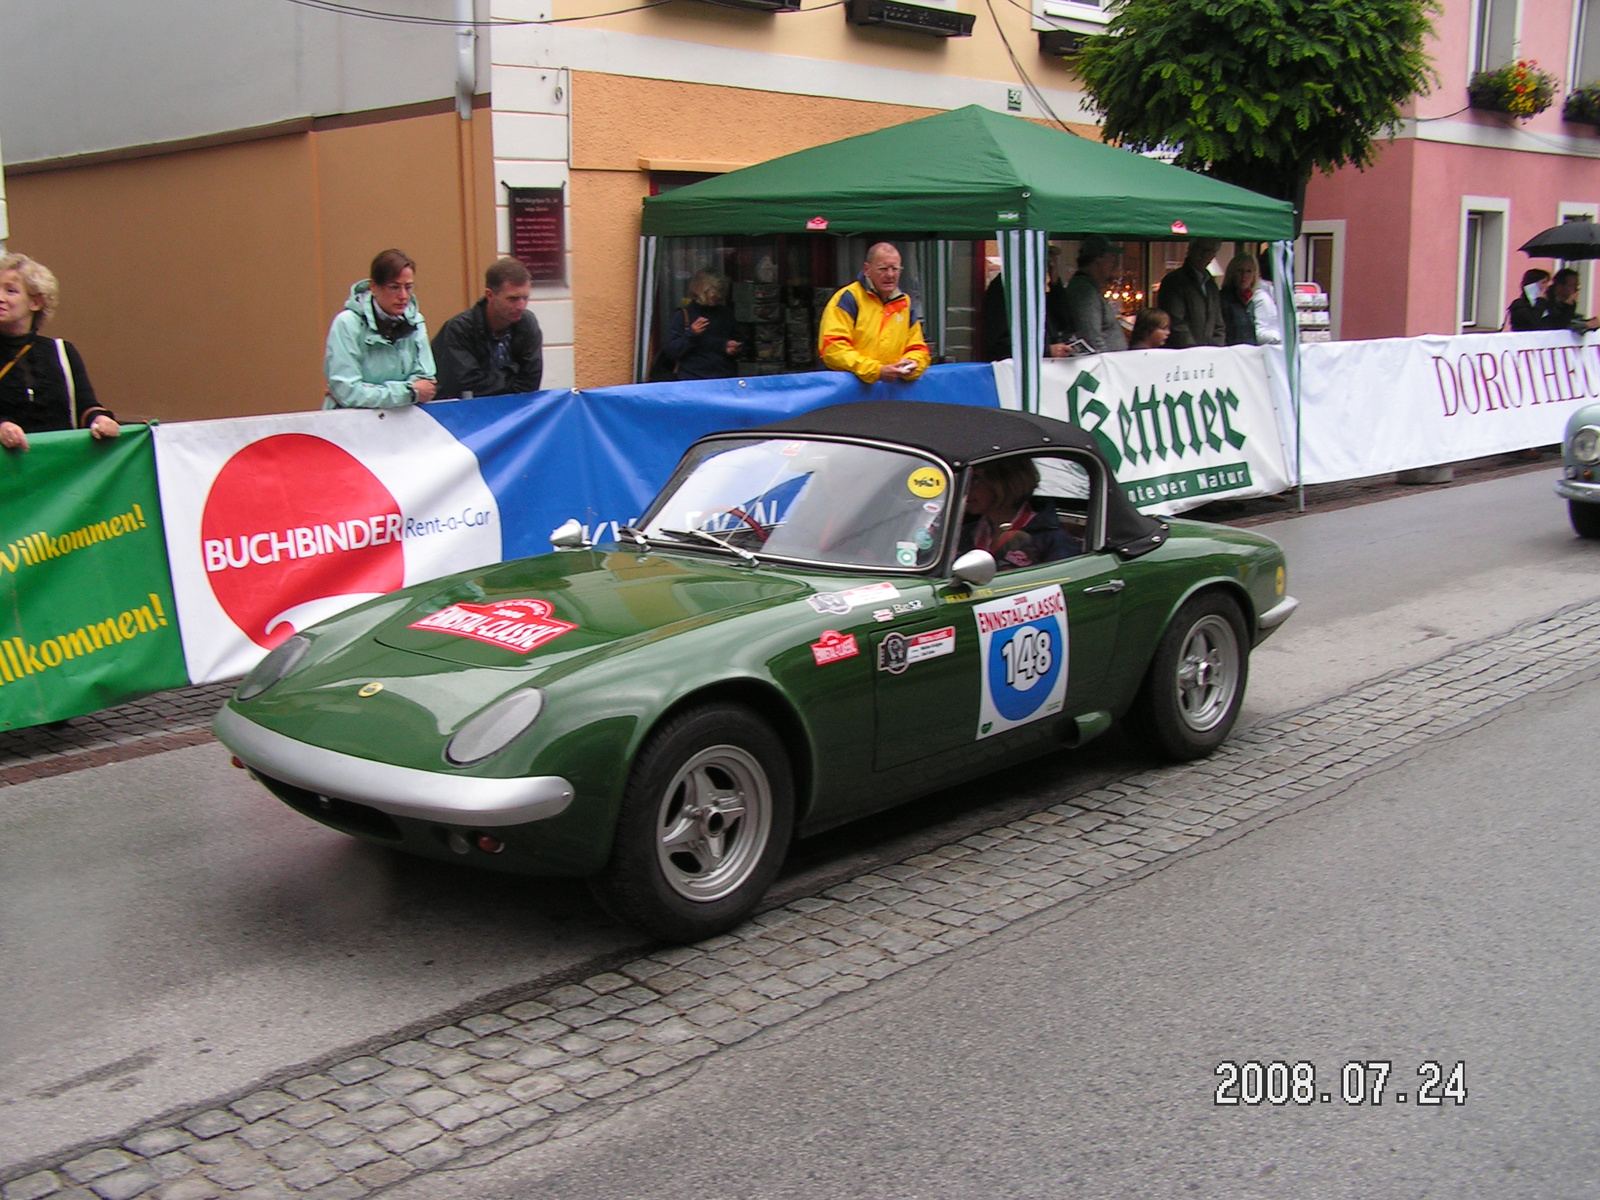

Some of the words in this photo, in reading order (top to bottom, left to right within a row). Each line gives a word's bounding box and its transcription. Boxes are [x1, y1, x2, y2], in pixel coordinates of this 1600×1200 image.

[1197, 470, 1244, 489] Natur
[204, 513, 402, 572] BUCHBINDER
[405, 508, 490, 538] Rent-a-Car
[418, 605, 565, 648] ENNSTAL-CLASSIC
[978, 592, 1064, 633] ENNSTAL-CLASSIC
[0, 593, 168, 687] llkommen!
[1001, 630, 1052, 686] 148
